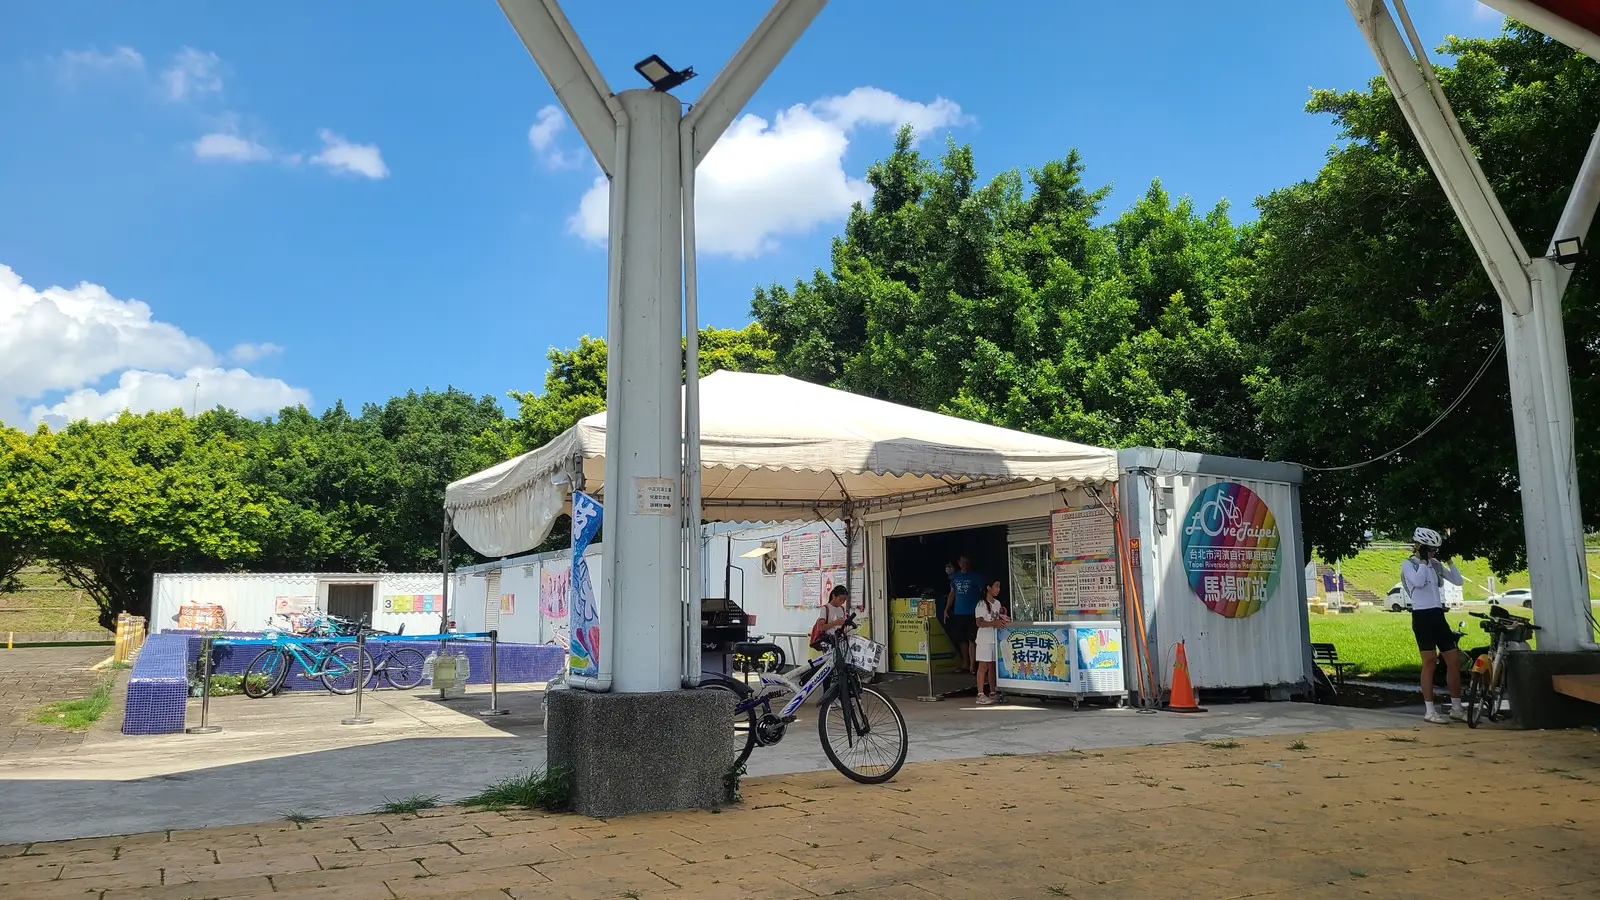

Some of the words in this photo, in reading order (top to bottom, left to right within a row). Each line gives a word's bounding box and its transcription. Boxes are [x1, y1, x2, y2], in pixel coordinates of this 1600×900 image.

[1237, 522, 1277, 544] Taipei
[1188, 561, 1204, 569] Taipei
[1205, 561, 1229, 569] Riverside
[1204, 576, 1268, 602] 馬場町站
[385, 600, 392, 609] 3
[1010, 637, 1054, 650] 古早味
[1012, 650, 1053, 664] 枝仔冰
